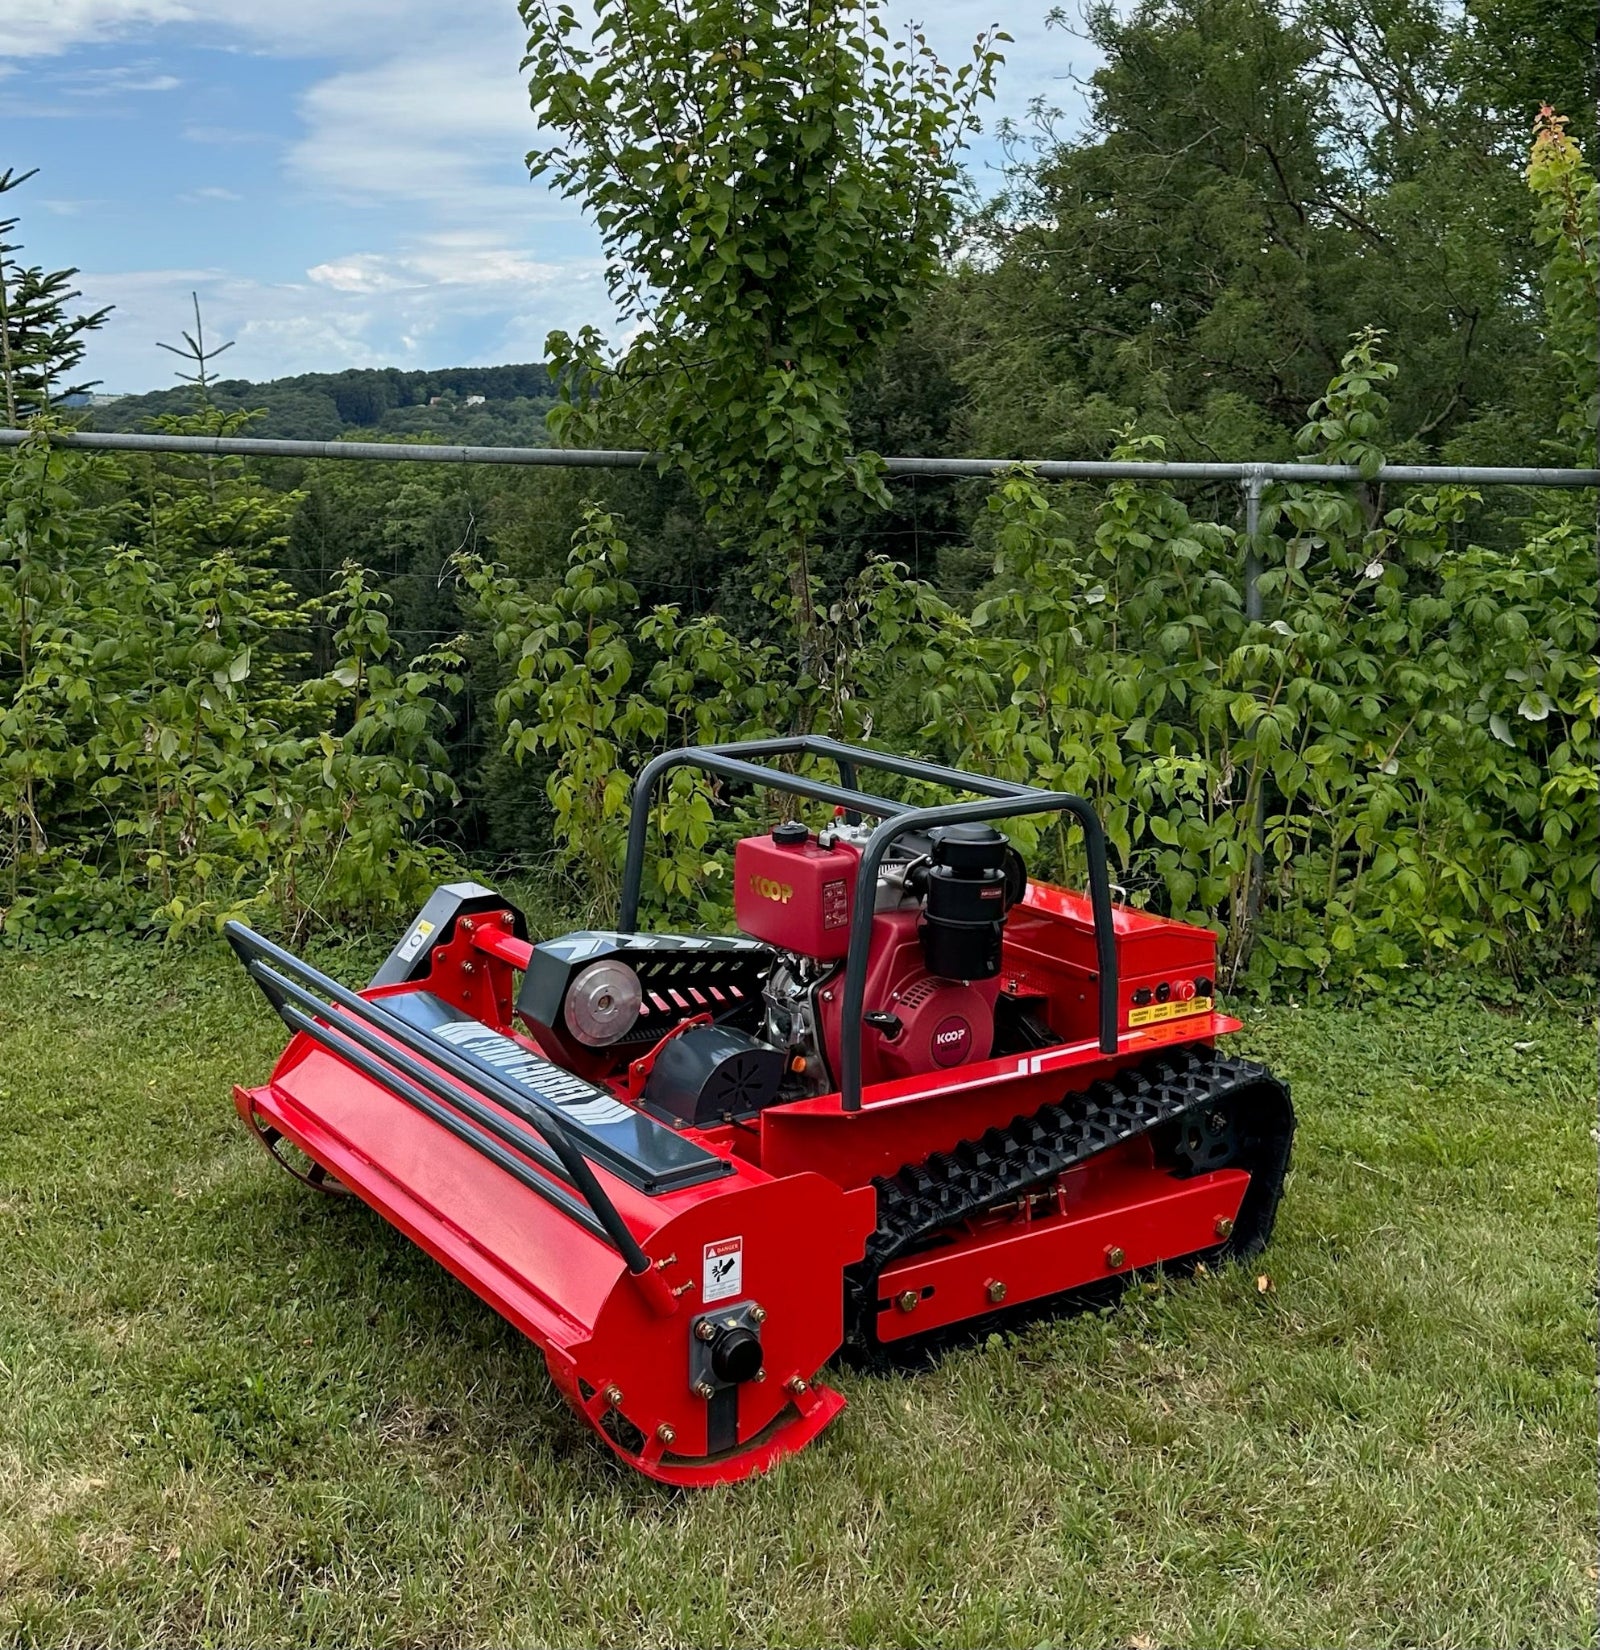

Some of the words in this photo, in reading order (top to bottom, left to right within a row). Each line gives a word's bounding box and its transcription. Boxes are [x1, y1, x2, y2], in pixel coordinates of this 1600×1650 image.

[750, 874, 792, 904] KOOP
[937, 1029, 965, 1045] KOOP
[462, 1037, 539, 1067] STRAW
[504, 1062, 598, 1104] CRUSHER
[717, 1243, 738, 1253] DANGER
